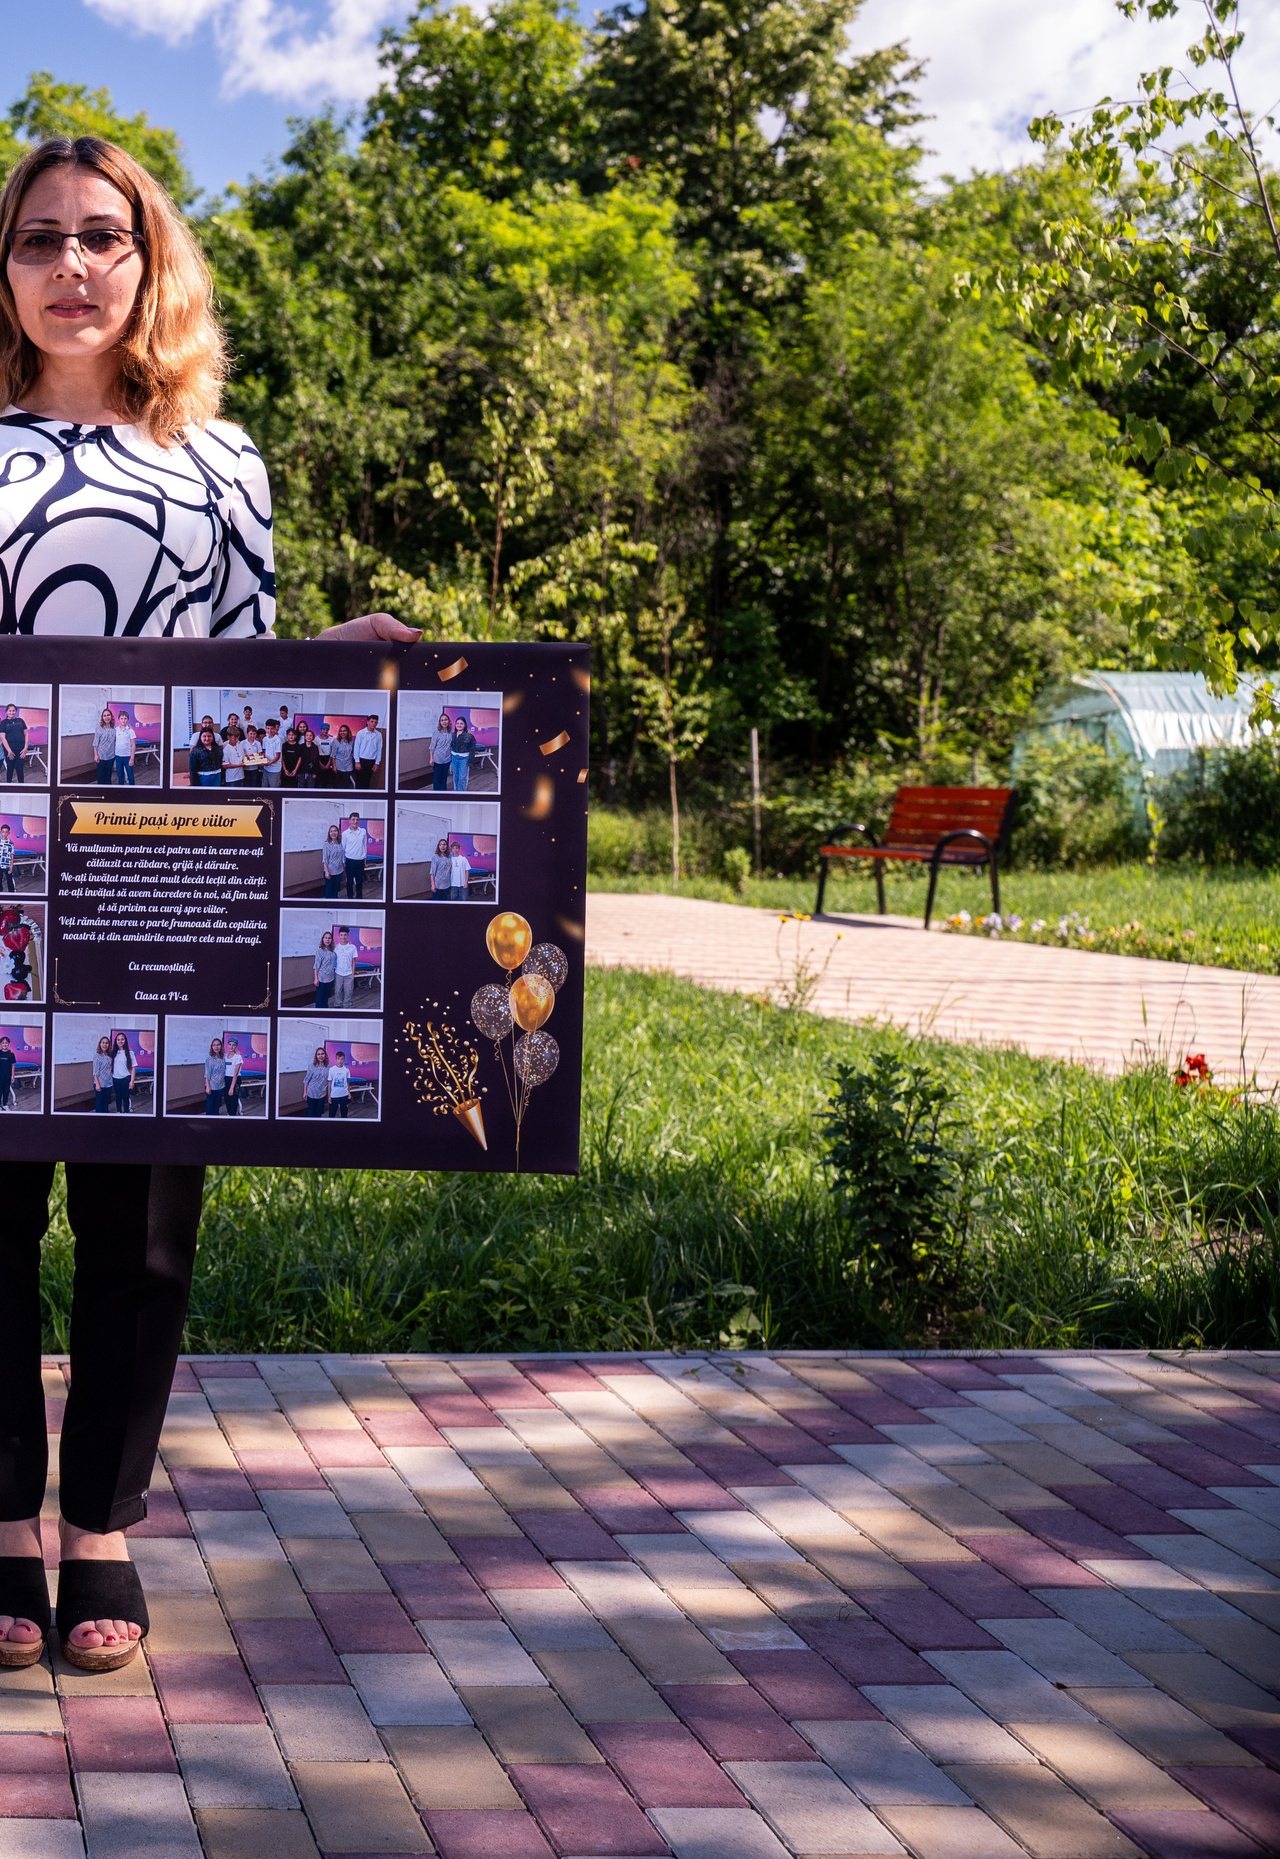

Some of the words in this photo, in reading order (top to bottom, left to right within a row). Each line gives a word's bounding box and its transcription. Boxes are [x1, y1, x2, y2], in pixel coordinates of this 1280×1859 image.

[94, 811, 137, 826] Primii
[171, 816, 199, 830] spre
[202, 814, 238, 828] viitor
[65, 842, 78, 853] Vă
[79, 844, 123, 855] mulțumim
[124, 845, 152, 856] pentru
[154, 845, 166, 854] cei
[166, 846, 191, 857] patru
[192, 846, 207, 855] ani
[208, 846, 217, 855] în
[86, 858, 121, 868] călăuzit
[134, 859, 171, 870] răbdare,
[172, 860, 193, 872] grijă
[204, 860, 239, 870] dăruire.
[120, 874, 140, 883] mult
[141, 875, 159, 883] mai
[160, 875, 180, 884] mult
[181, 875, 205, 885] decât
[227, 877, 243, 885] din
[116, 888, 128, 897] să
[128, 890, 152, 898] avem
[152, 889, 192, 899] încredere
[193, 890, 203, 899] în
[203, 890, 220, 900] noi,
[221, 890, 232, 900] să
[231, 890, 249, 902] fim
[249, 891, 269, 900] buni
[107, 902, 118, 912] să
[118, 903, 147, 914] privim
[148, 905, 160, 913] cu
[160, 904, 183, 915] curaj
[184, 906, 202, 915] spre
[203, 904, 228, 914] viitor.
[77, 916, 111, 926] rămâne
[111, 919, 139, 927] mereu
[146, 919, 169, 930] parte
[168, 918, 213, 930] frumoasă
[212, 920, 229, 929] din
[228, 920, 268, 931] copilăria
[62, 931, 96, 941] noastră
[106, 932, 122, 941] din
[122, 932, 166, 942] amintirile
[165, 933, 198, 943] noastre
[199, 934, 216, 943] cele
[216, 935, 235, 943] mai
[235, 934, 262, 946] dragi.
[128, 961, 141, 971] Cu
[134, 990, 158, 1001] Clasa
[168, 991, 189, 1001] IV-a
